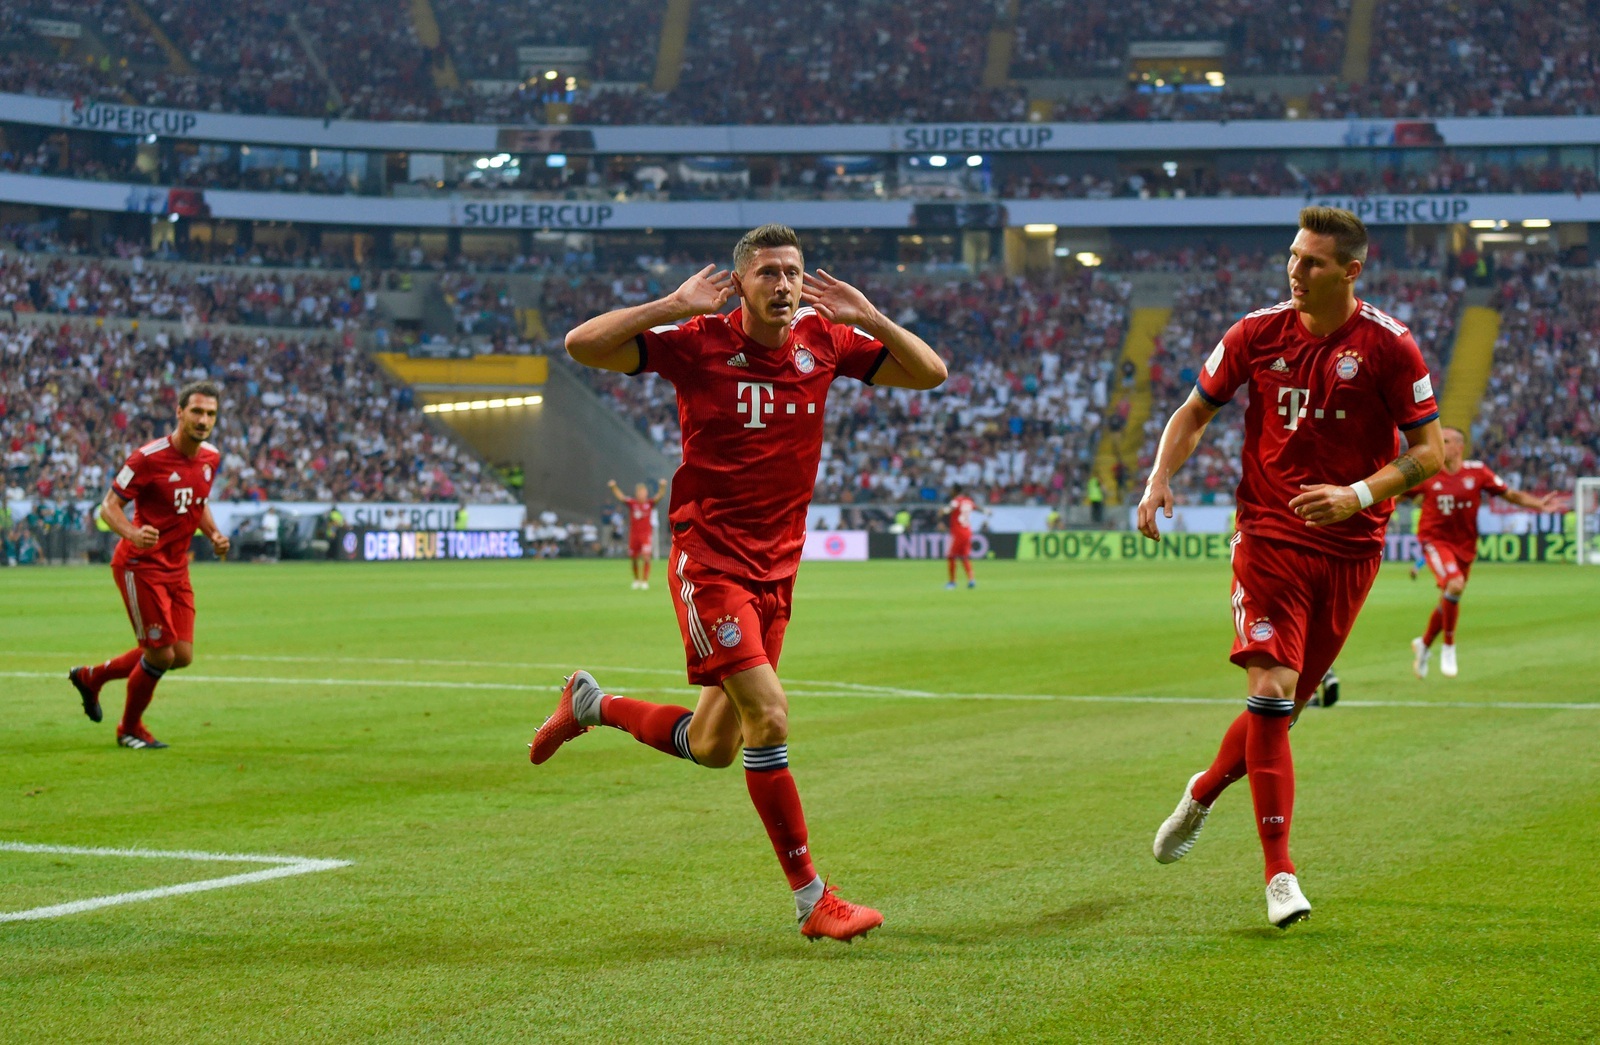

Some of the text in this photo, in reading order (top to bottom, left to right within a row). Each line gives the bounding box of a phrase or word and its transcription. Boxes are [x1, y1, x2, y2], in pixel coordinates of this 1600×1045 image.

[72, 104, 196, 134] SUPERCUP
[904, 127, 1053, 149] SUPERCUP
[464, 203, 613, 226] SUPERCUP
[1317, 199, 1469, 221] PERCUP
[354, 508, 462, 530] SURCU
[363, 531, 399, 560] DER
[401, 531, 445, 559] NEUE
[1030, 533, 1112, 558] 100%
[1262, 815, 1284, 824] FCB
[789, 845, 807, 858] FCB
